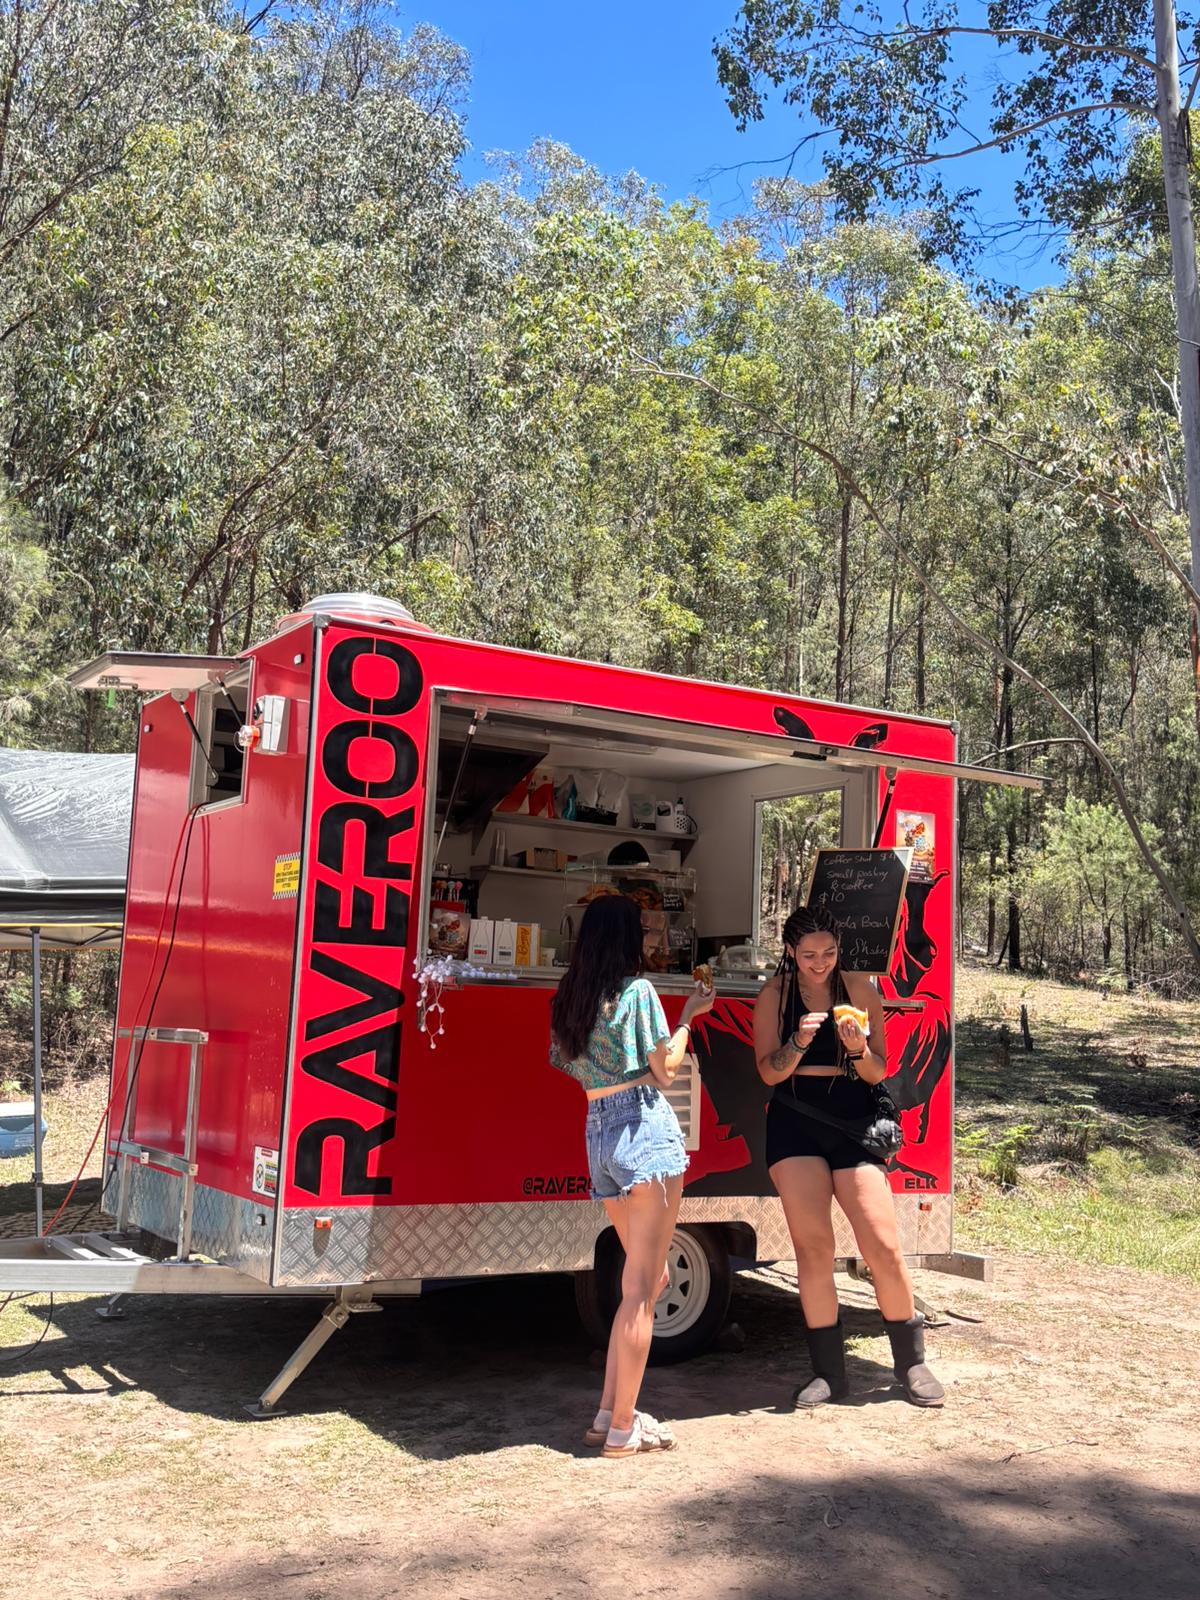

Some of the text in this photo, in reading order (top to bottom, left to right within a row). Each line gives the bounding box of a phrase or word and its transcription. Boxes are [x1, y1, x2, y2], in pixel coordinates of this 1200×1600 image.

[818, 891, 845, 905] $10
[294, 637, 424, 1196] RAVEROO
[904, 1177, 938, 1190] ELK
